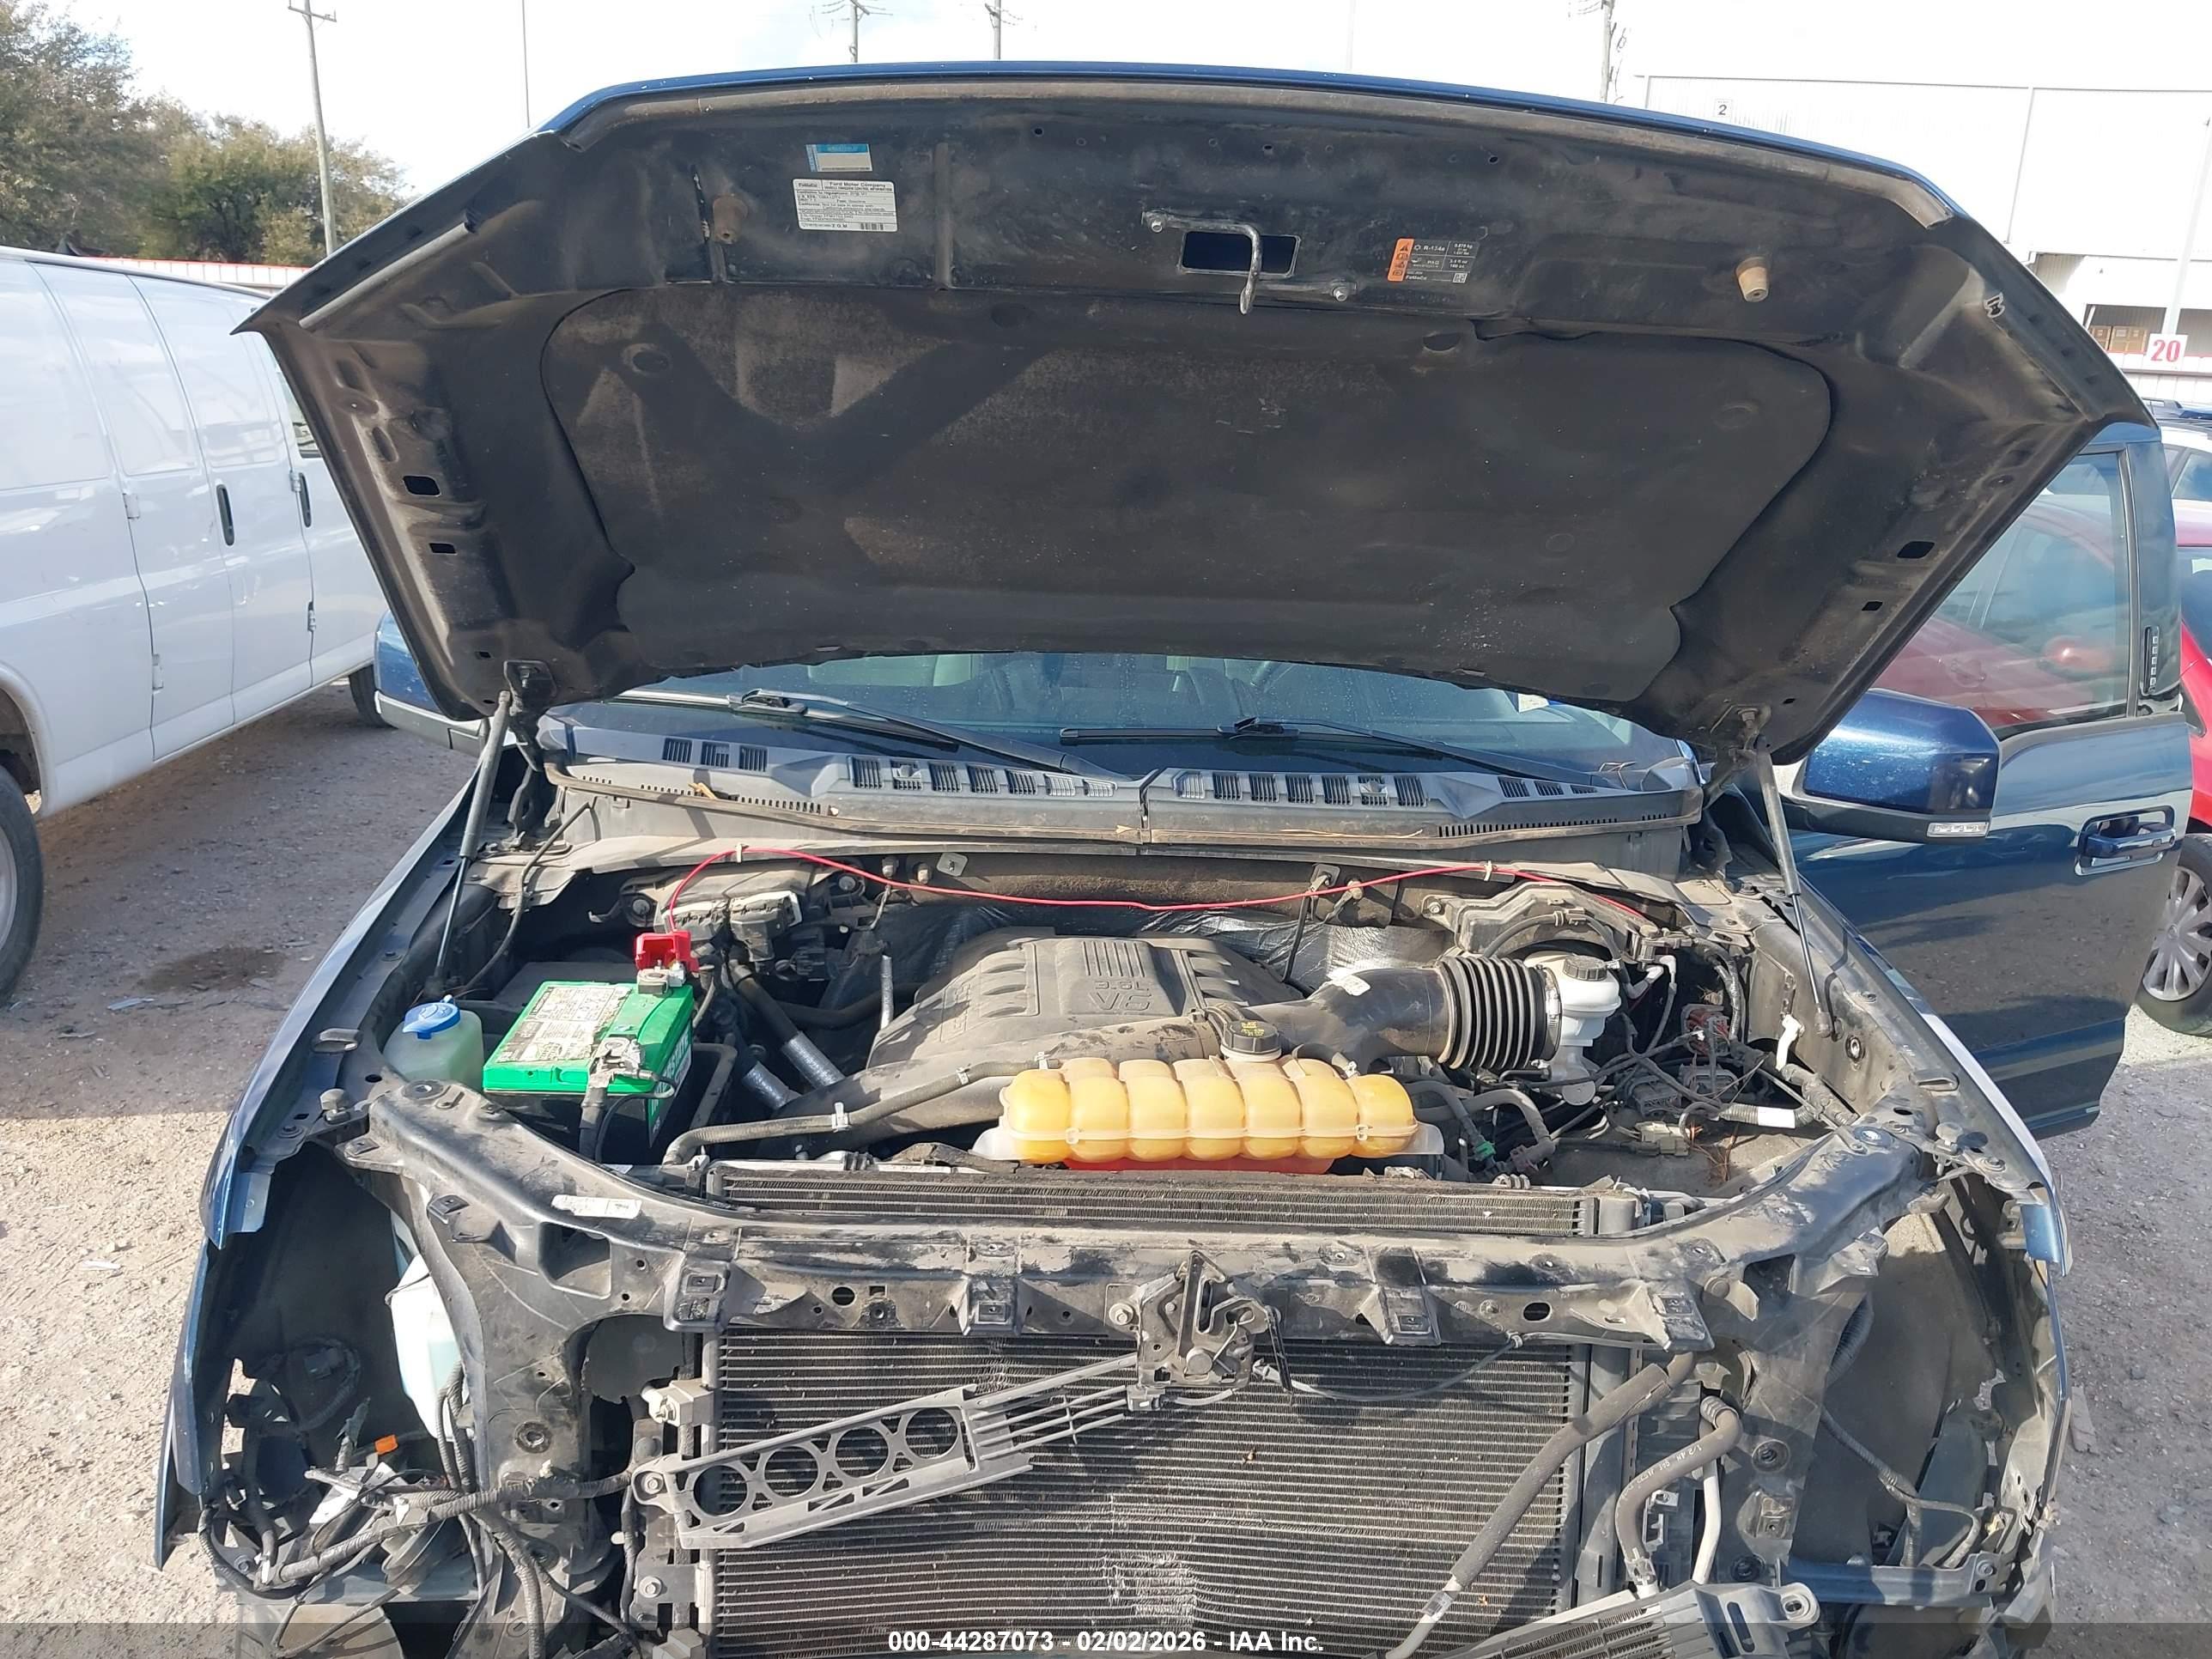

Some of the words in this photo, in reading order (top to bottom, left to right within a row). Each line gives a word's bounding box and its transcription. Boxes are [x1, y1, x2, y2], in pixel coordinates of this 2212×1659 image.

[1718, 104, 1728, 115] 2
[2150, 339, 2181, 362] 20
[1088, 992, 1152, 1012] V6
